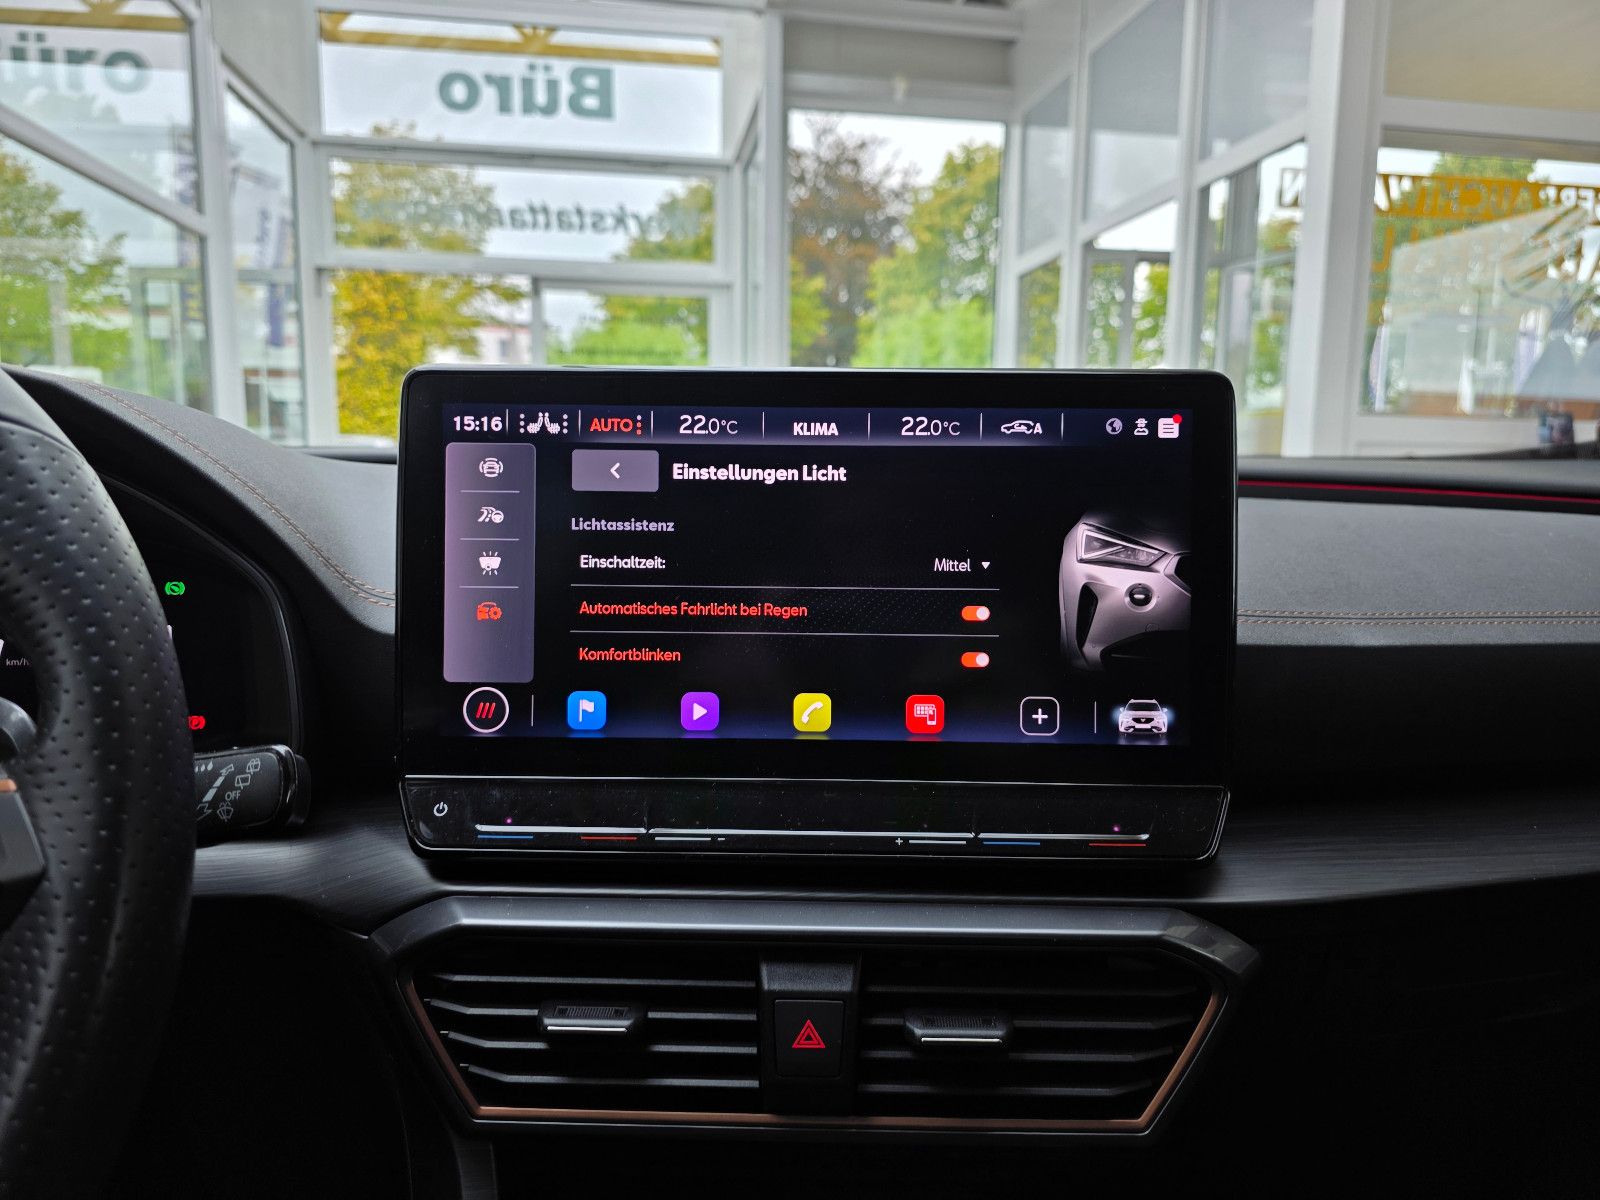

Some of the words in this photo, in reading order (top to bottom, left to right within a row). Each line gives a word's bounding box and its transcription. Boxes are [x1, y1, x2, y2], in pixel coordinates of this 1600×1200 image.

[453, 415, 503, 432] 15:16
[589, 417, 633, 433] AUTO
[793, 421, 839, 437] KLIMA
[672, 462, 799, 485] Einstellungen
[802, 464, 847, 482] Licht
[571, 517, 675, 533] Lichtassistenz
[579, 554, 666, 571] Einschaltzeit:
[933, 557, 971, 573] Mittel
[579, 600, 678, 617] Automatisches
[680, 601, 738, 617] Fahrlicht
[740, 602, 762, 618] bei
[763, 602, 808, 619] Regen
[5, 657, 30, 668] km/h
[578, 647, 681, 663] Komfortblinken
[225, 791, 241, 801] OFF
